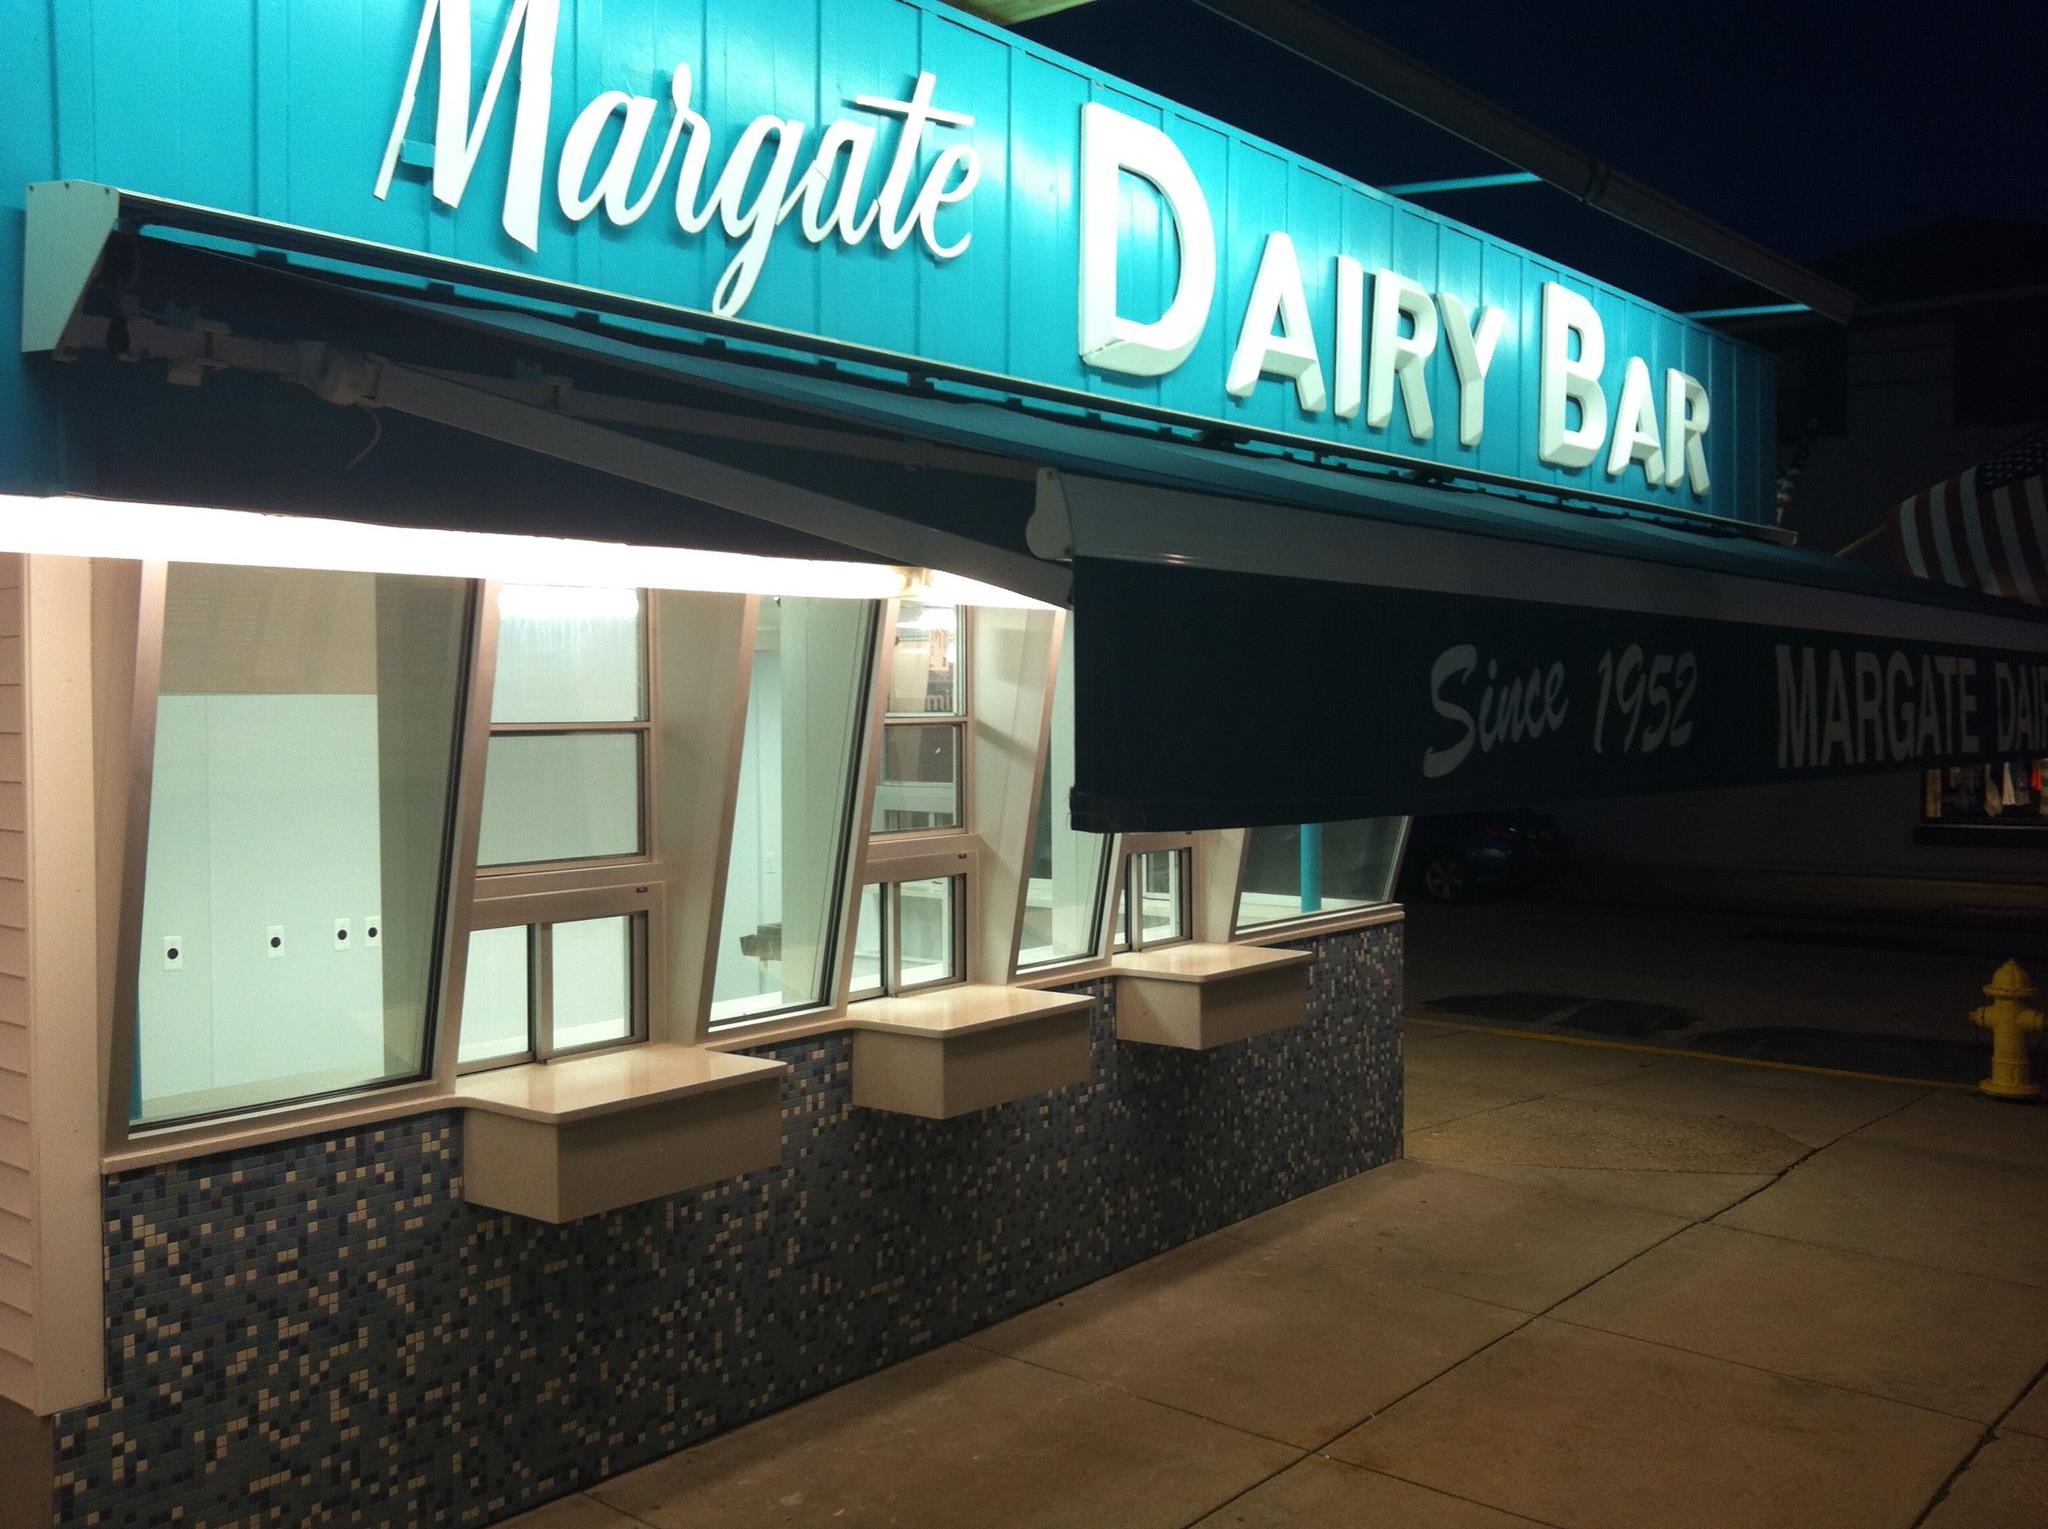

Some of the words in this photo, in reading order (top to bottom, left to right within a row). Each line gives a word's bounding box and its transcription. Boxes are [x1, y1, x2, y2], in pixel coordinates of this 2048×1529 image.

[374, 0, 982, 318] Margate
[1078, 101, 1506, 447] DAIRY
[1538, 280, 1712, 496] BAR
[1422, 643, 1569, 779] Since
[1593, 642, 1699, 755] 1952
[1775, 644, 1981, 769] MARGATE
